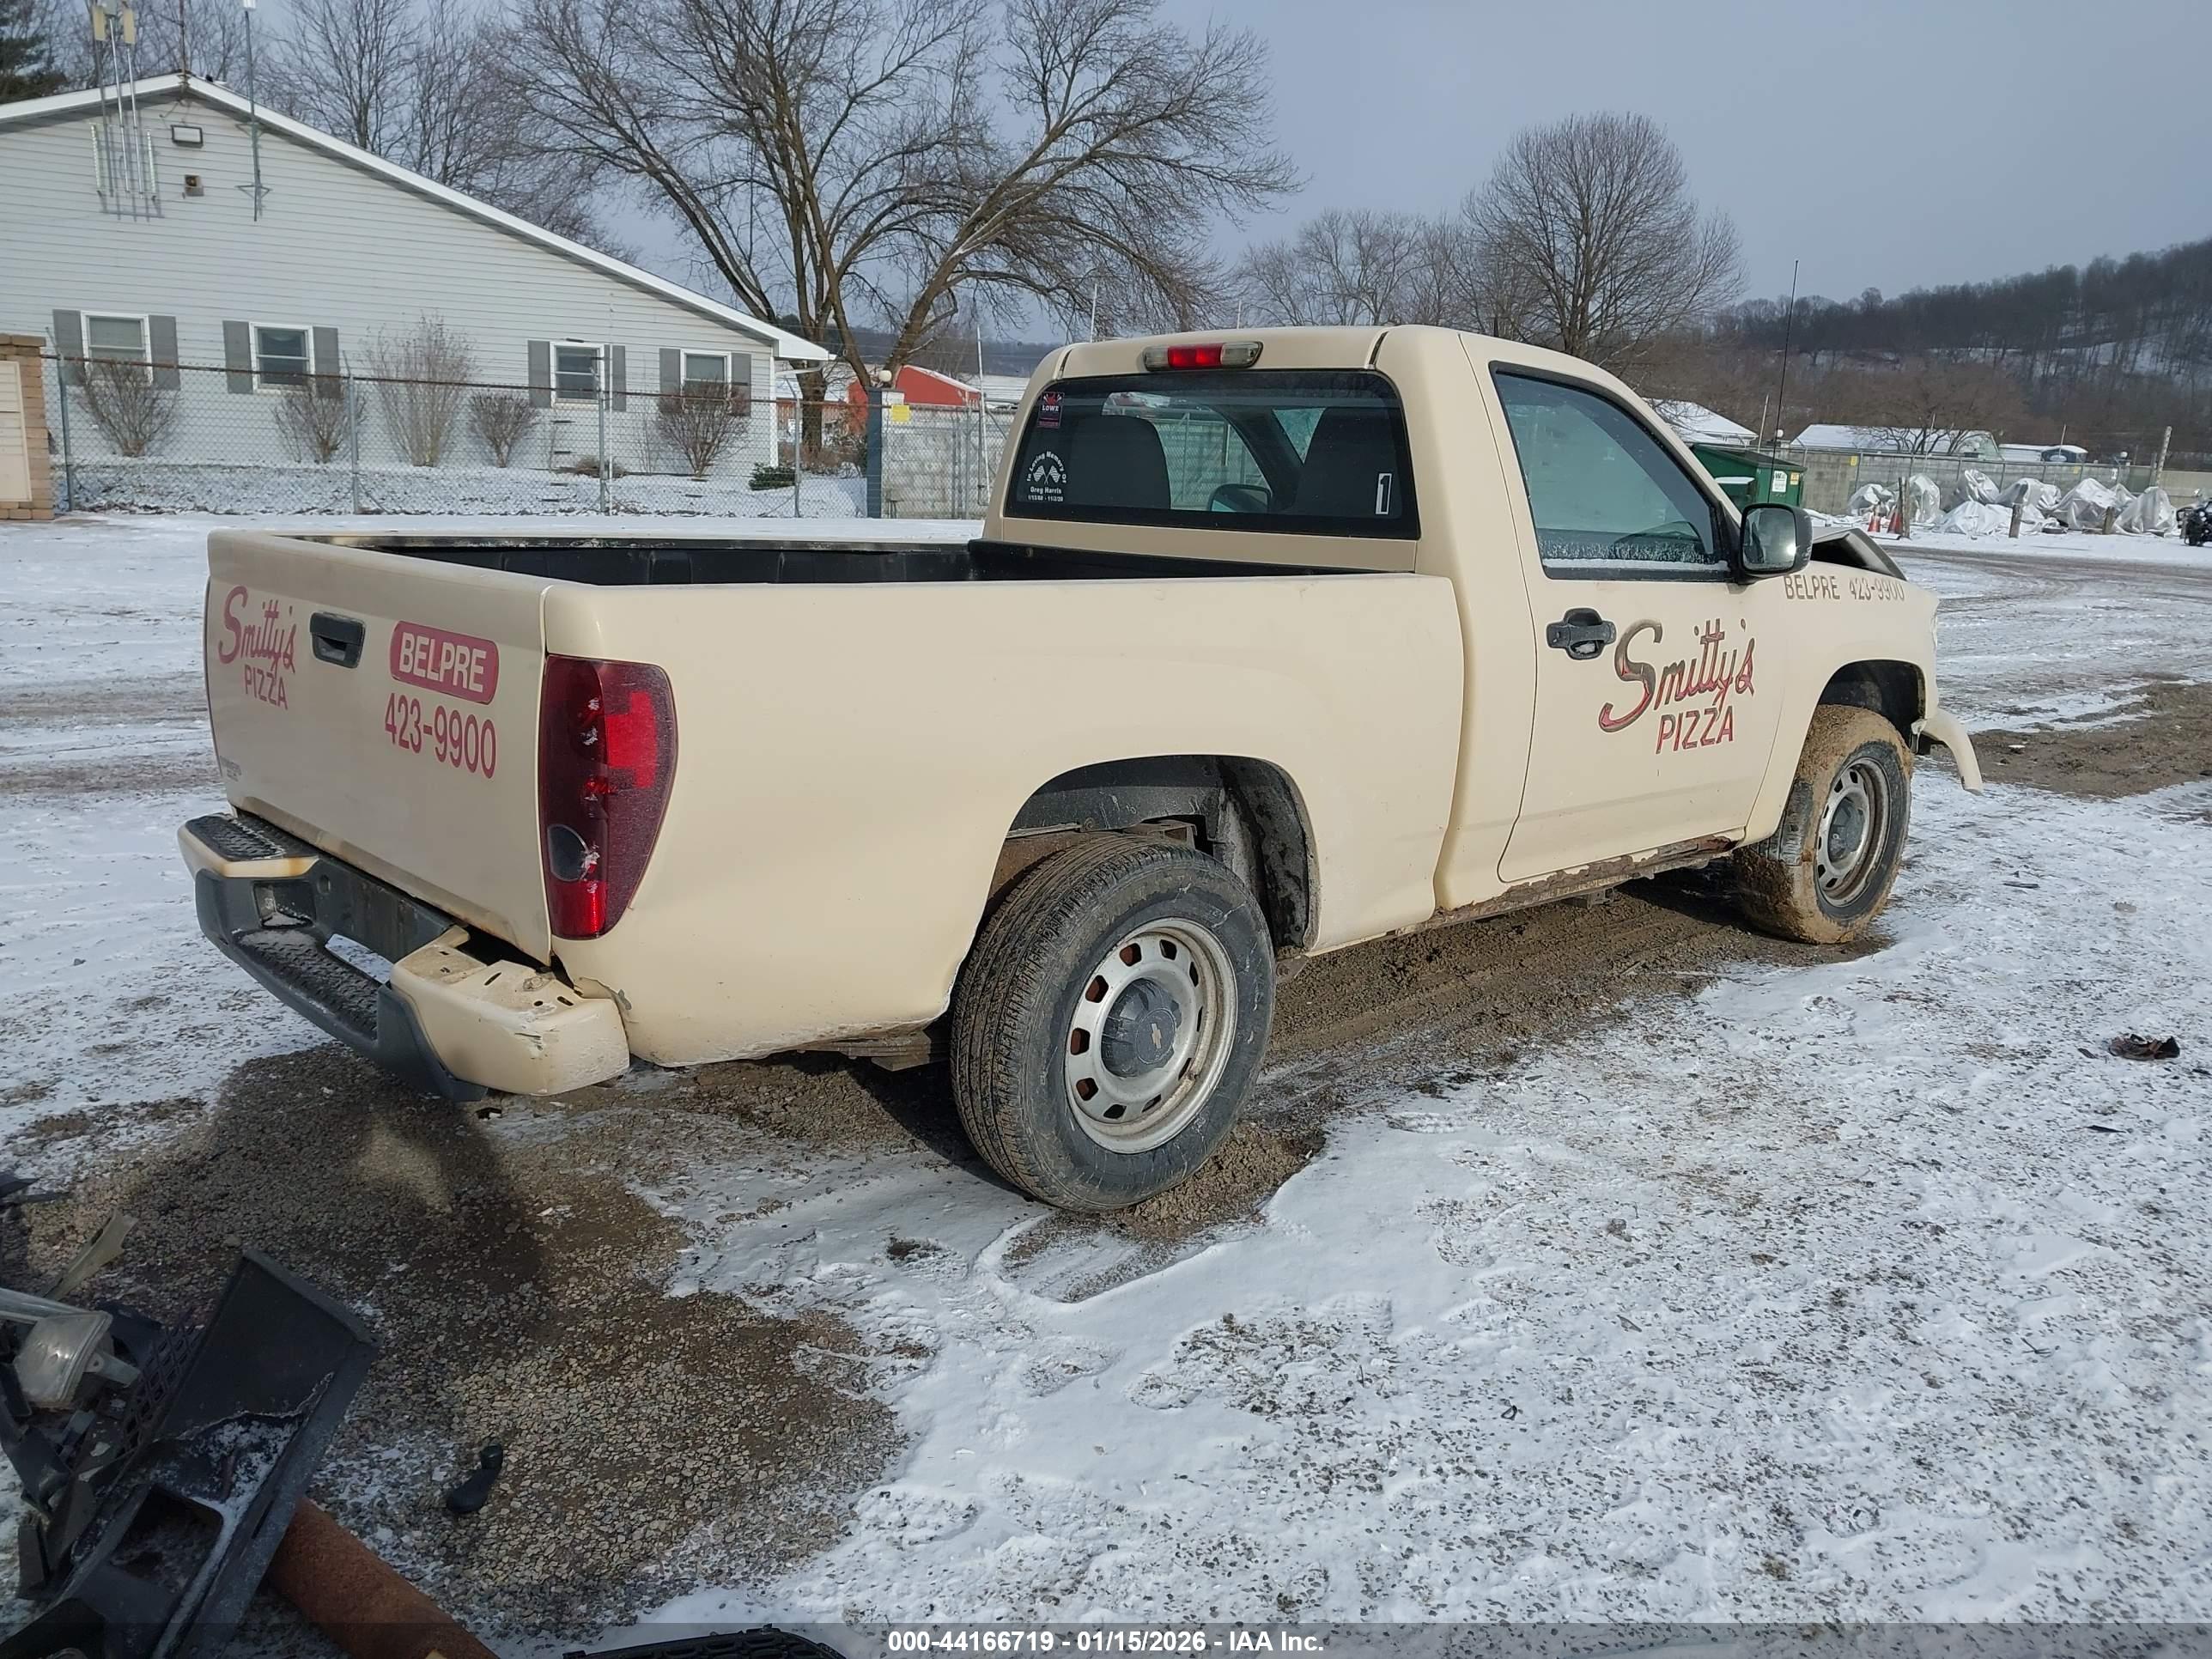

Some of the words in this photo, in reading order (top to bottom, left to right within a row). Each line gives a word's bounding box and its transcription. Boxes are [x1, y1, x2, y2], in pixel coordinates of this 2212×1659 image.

[1029, 453, 1046, 472] Loving
[1046, 451, 1065, 471] Memory
[1784, 574, 1840, 599] BELPRE
[1849, 577, 1905, 601] 423-9900
[218, 585, 297, 674] Smitty's
[244, 665, 289, 710] PIZZA
[399, 632, 487, 692] BELPRE
[1598, 617, 1756, 733] Smitty's
[385, 692, 497, 780] 423-9900
[1656, 704, 1734, 754] PIZZA
